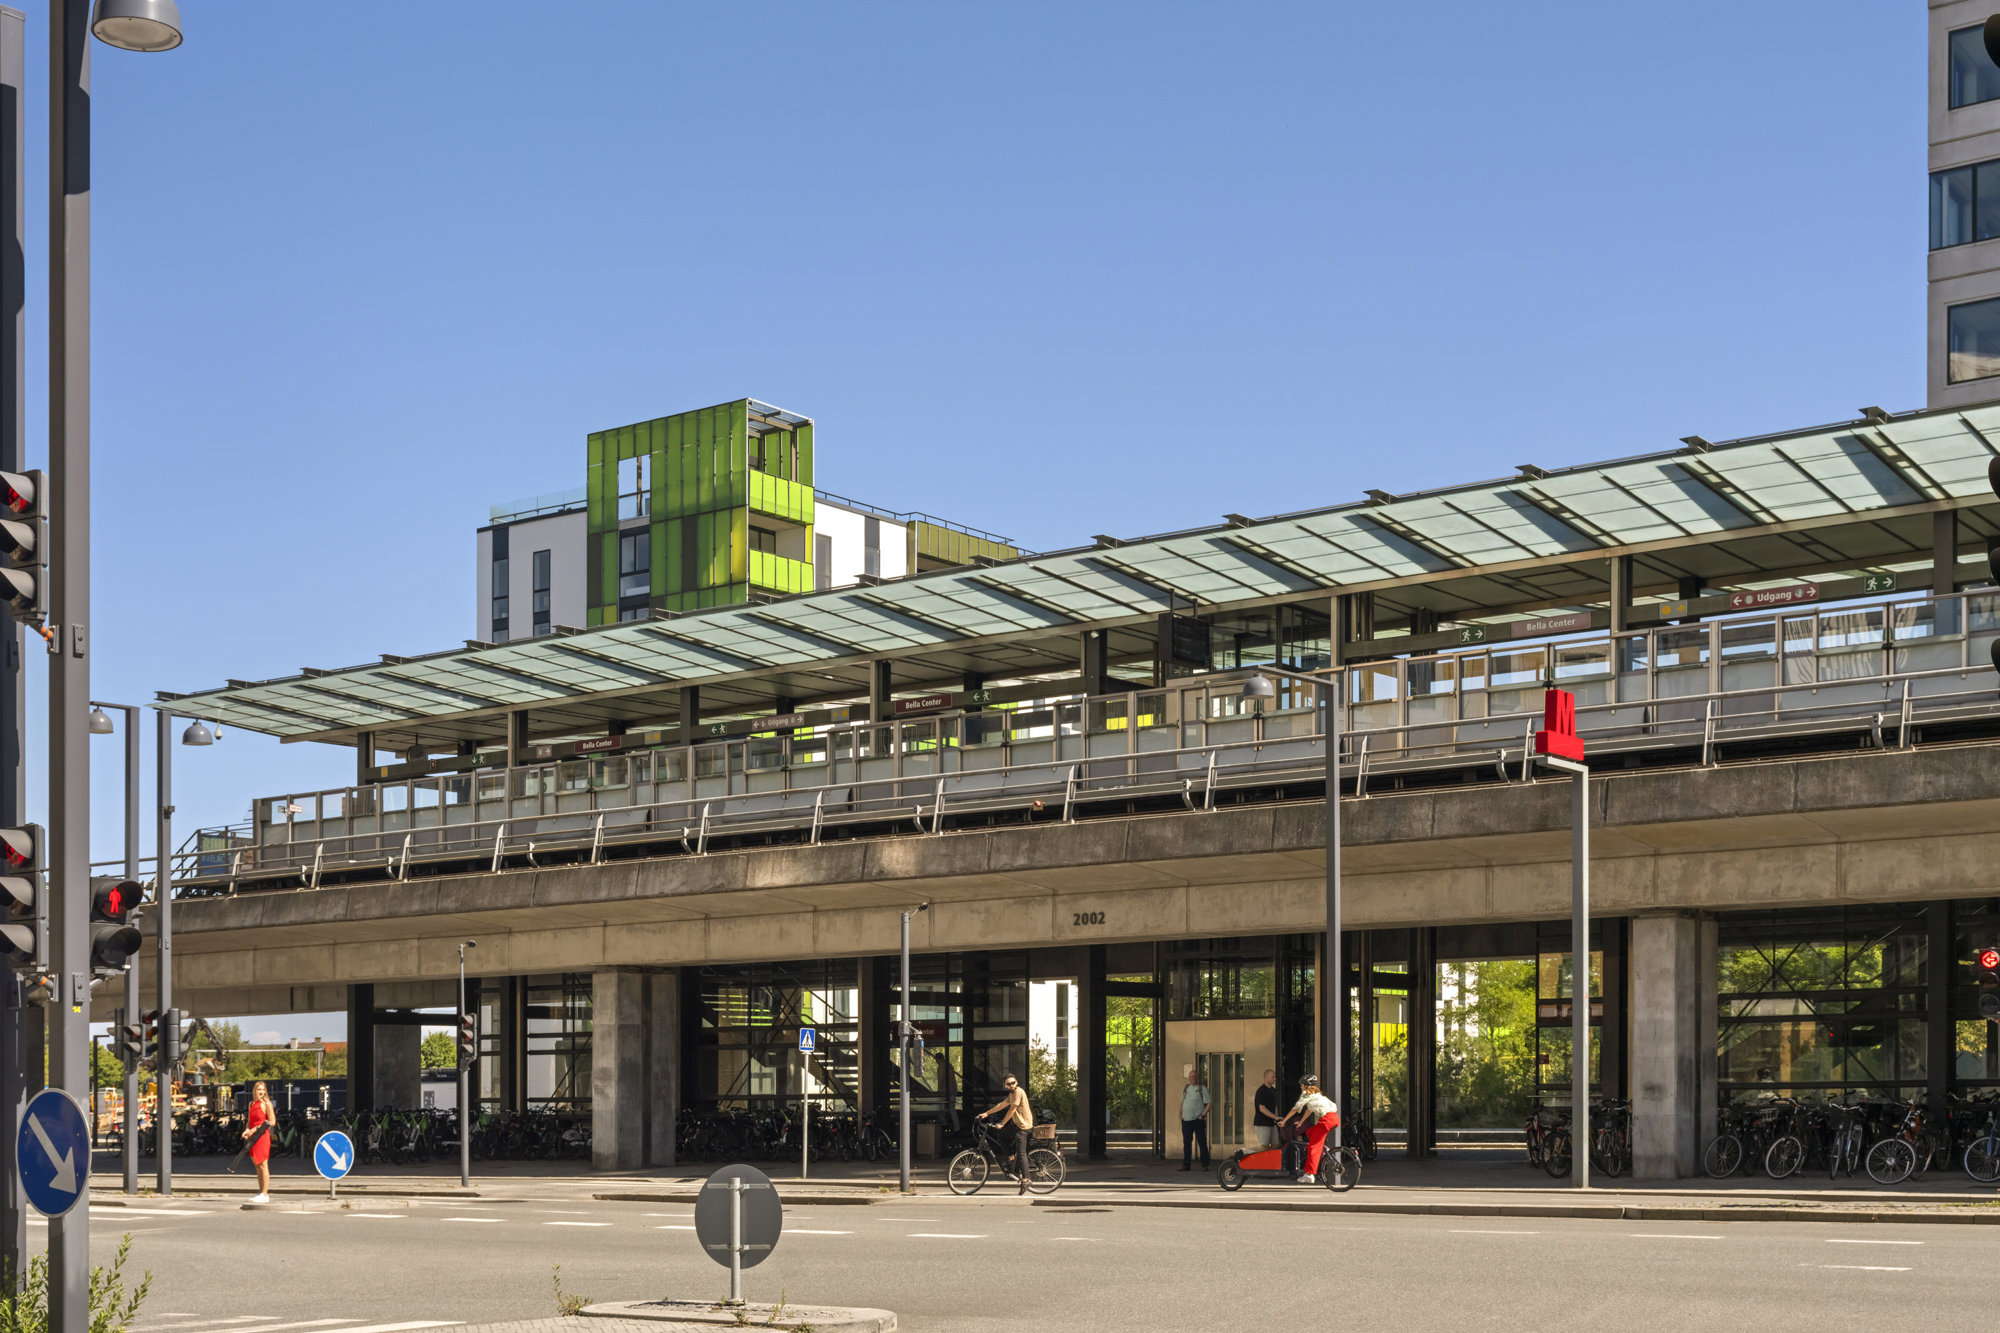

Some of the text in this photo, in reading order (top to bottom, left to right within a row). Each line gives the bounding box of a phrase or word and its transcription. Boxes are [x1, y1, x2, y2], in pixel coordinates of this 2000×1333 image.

[1757, 591, 1792, 603] Udgang
[1526, 618, 1576, 631] Bella Center
[905, 698, 942, 709] Bella Center
[1549, 689, 1577, 738] M
[582, 740, 613, 750] Bella Center
[1073, 911, 1106, 926] 2002
